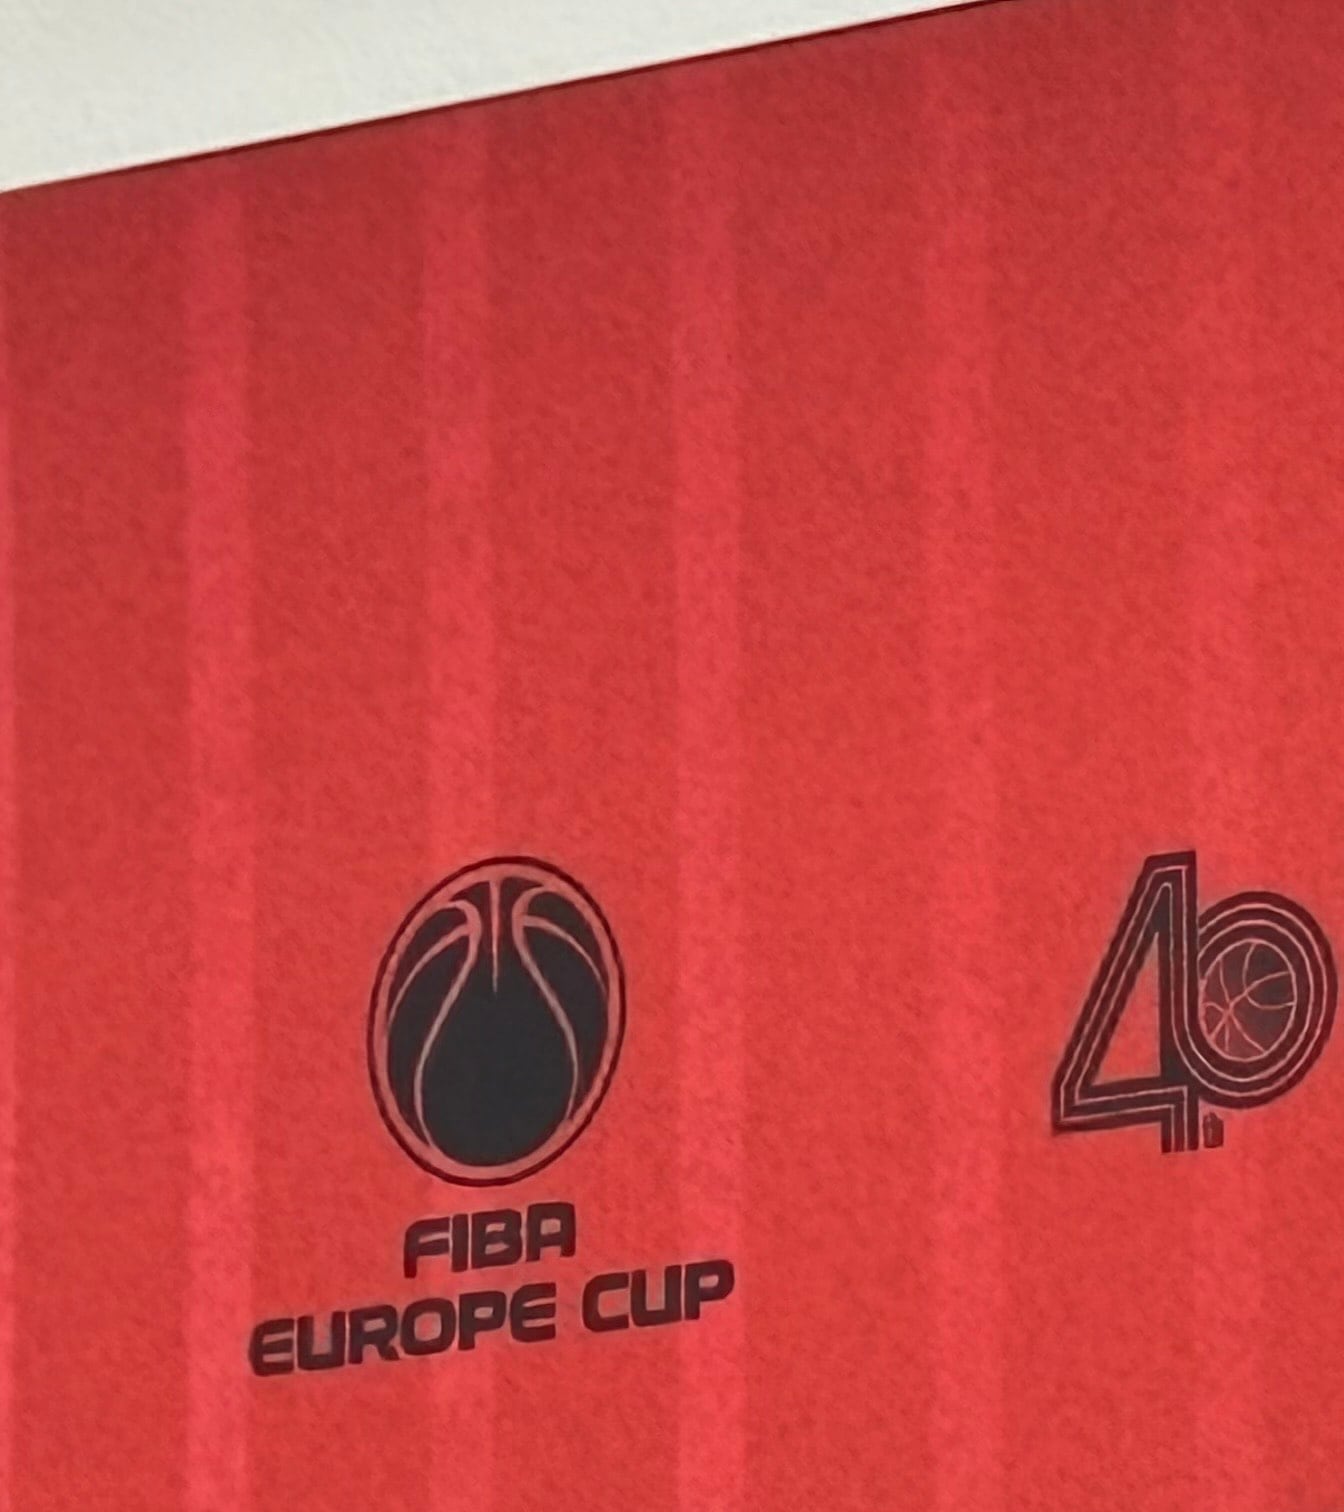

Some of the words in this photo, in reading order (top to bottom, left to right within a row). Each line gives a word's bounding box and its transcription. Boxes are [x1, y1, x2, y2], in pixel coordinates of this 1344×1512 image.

[403, 1203, 577, 1279] FIBA
[249, 1281, 557, 1377] EUROPE
[581, 1259, 736, 1335] CUP
